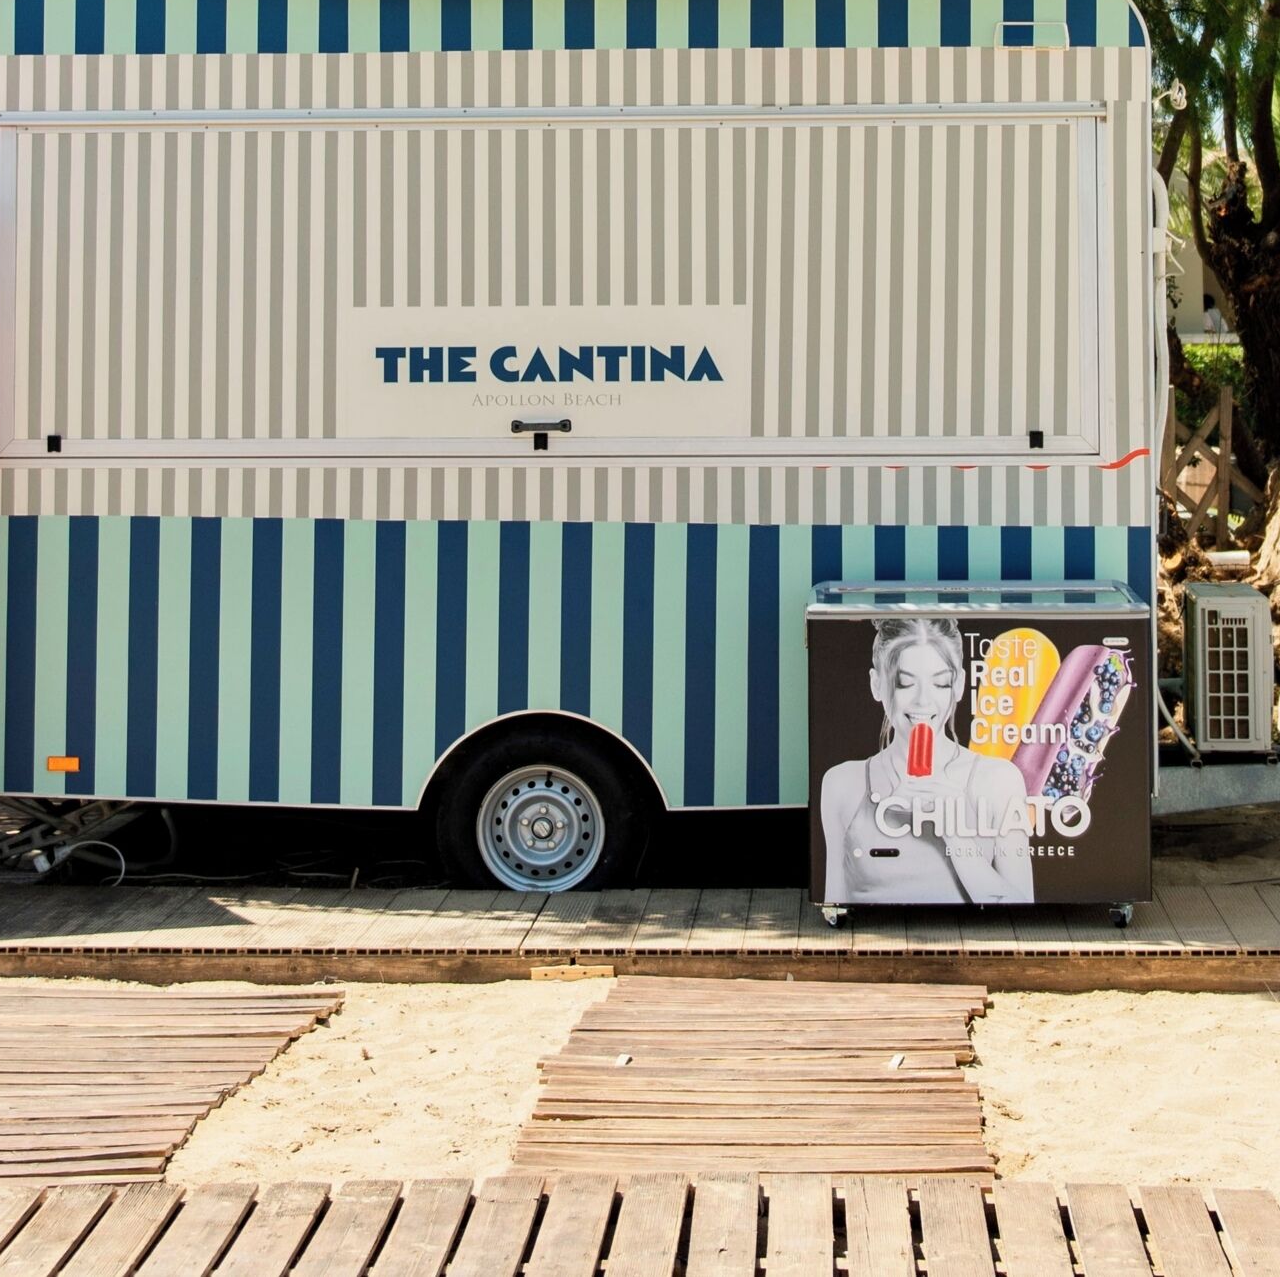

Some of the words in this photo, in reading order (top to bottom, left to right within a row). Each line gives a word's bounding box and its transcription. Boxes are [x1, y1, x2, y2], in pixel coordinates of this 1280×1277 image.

[375, 345, 477, 383] THE
[489, 345, 724, 383] CANTINA
[472, 393, 555, 407] APOLLON
[563, 392, 622, 406] BEACH
[964, 633, 1037, 659] Taste
[970, 660, 1035, 687] Real
[971, 689, 1014, 716] Ice
[970, 717, 1066, 744] Cream
[875, 795, 1091, 838] CHILLATO
[945, 846, 983, 858] BORN
[1016, 845, 1075, 857] GREECE
